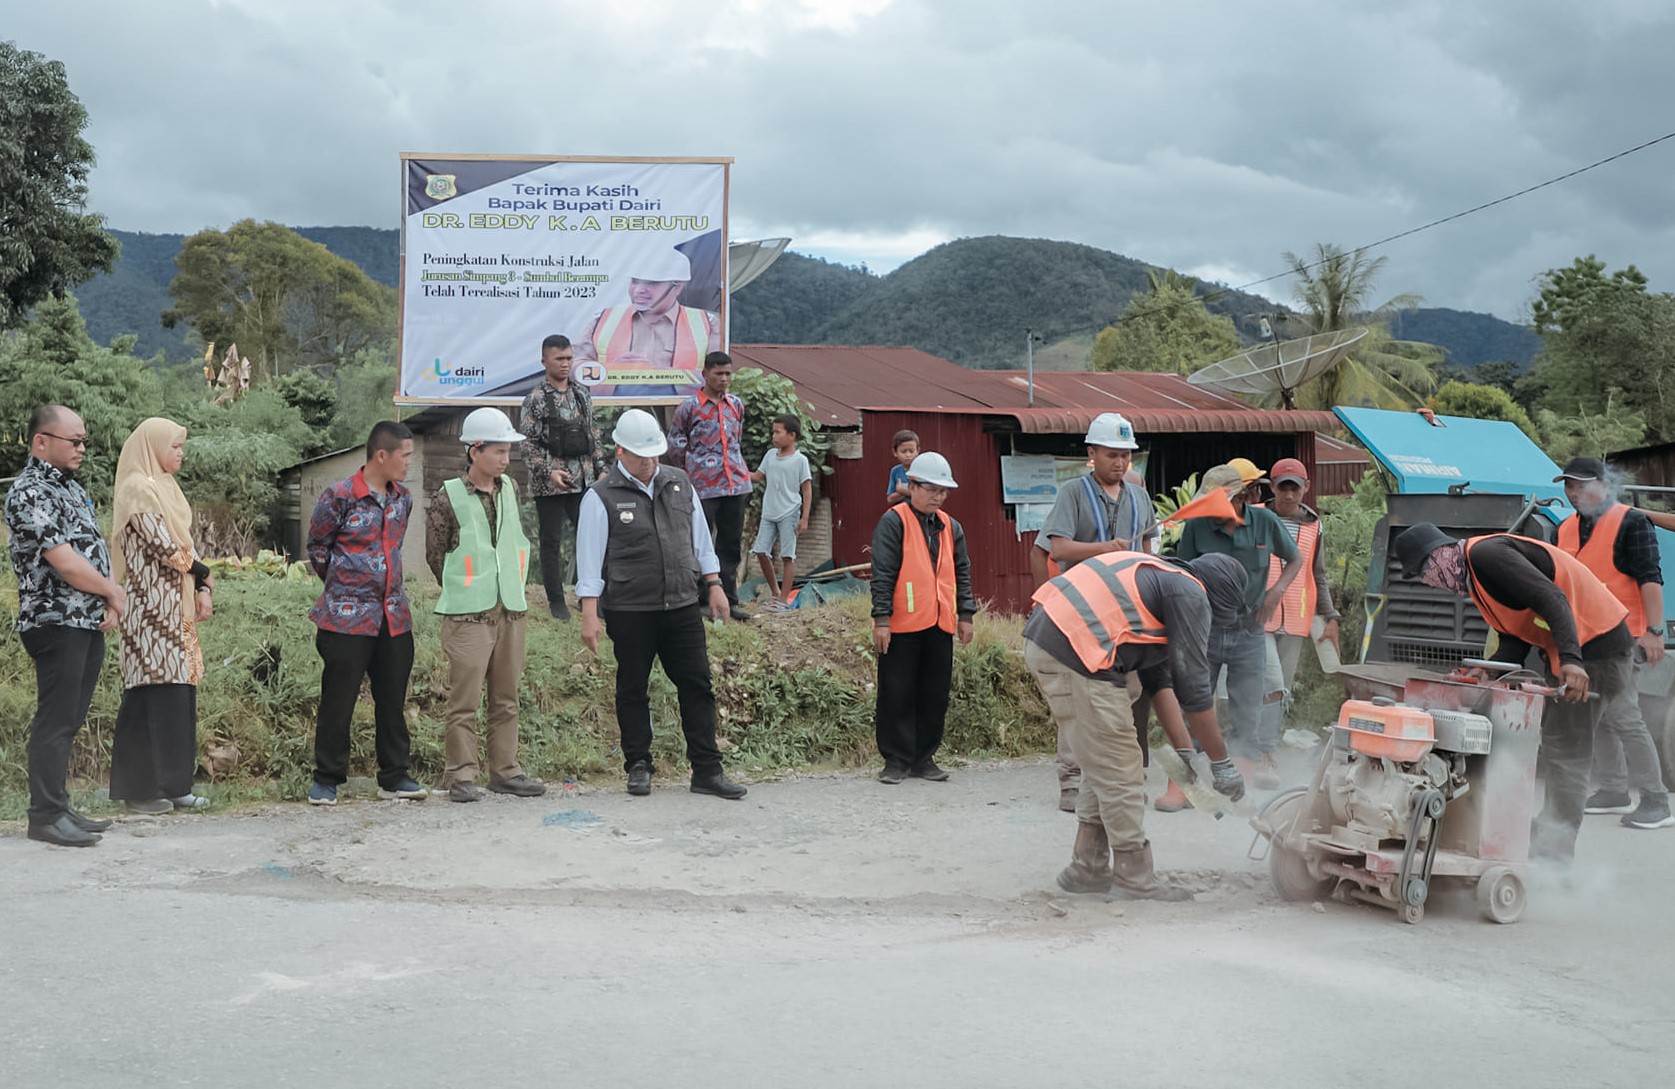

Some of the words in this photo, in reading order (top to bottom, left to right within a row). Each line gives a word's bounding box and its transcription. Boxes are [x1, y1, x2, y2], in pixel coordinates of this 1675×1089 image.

[512, 183, 580, 197] Terima
[586, 184, 639, 197] Kasih
[488, 198, 548, 211] Bapak
[554, 199, 614, 213] Bupati
[619, 199, 661, 211] Dairi
[423, 213, 464, 229] DR.
[469, 213, 540, 230] EDDY
[610, 215, 709, 231] BERUTU
[423, 253, 497, 268] Peningkatan
[501, 254, 564, 267] Konstruksi
[567, 255, 599, 268] Jalan
[463, 270, 508, 285] Simpang
[422, 284, 455, 297] Telah
[459, 285, 520, 298] Terealisasi
[523, 286, 560, 298] Tahun
[564, 286, 596, 298] 2023
[455, 366, 485, 376] dairi
[439, 376, 485, 387] unggul
